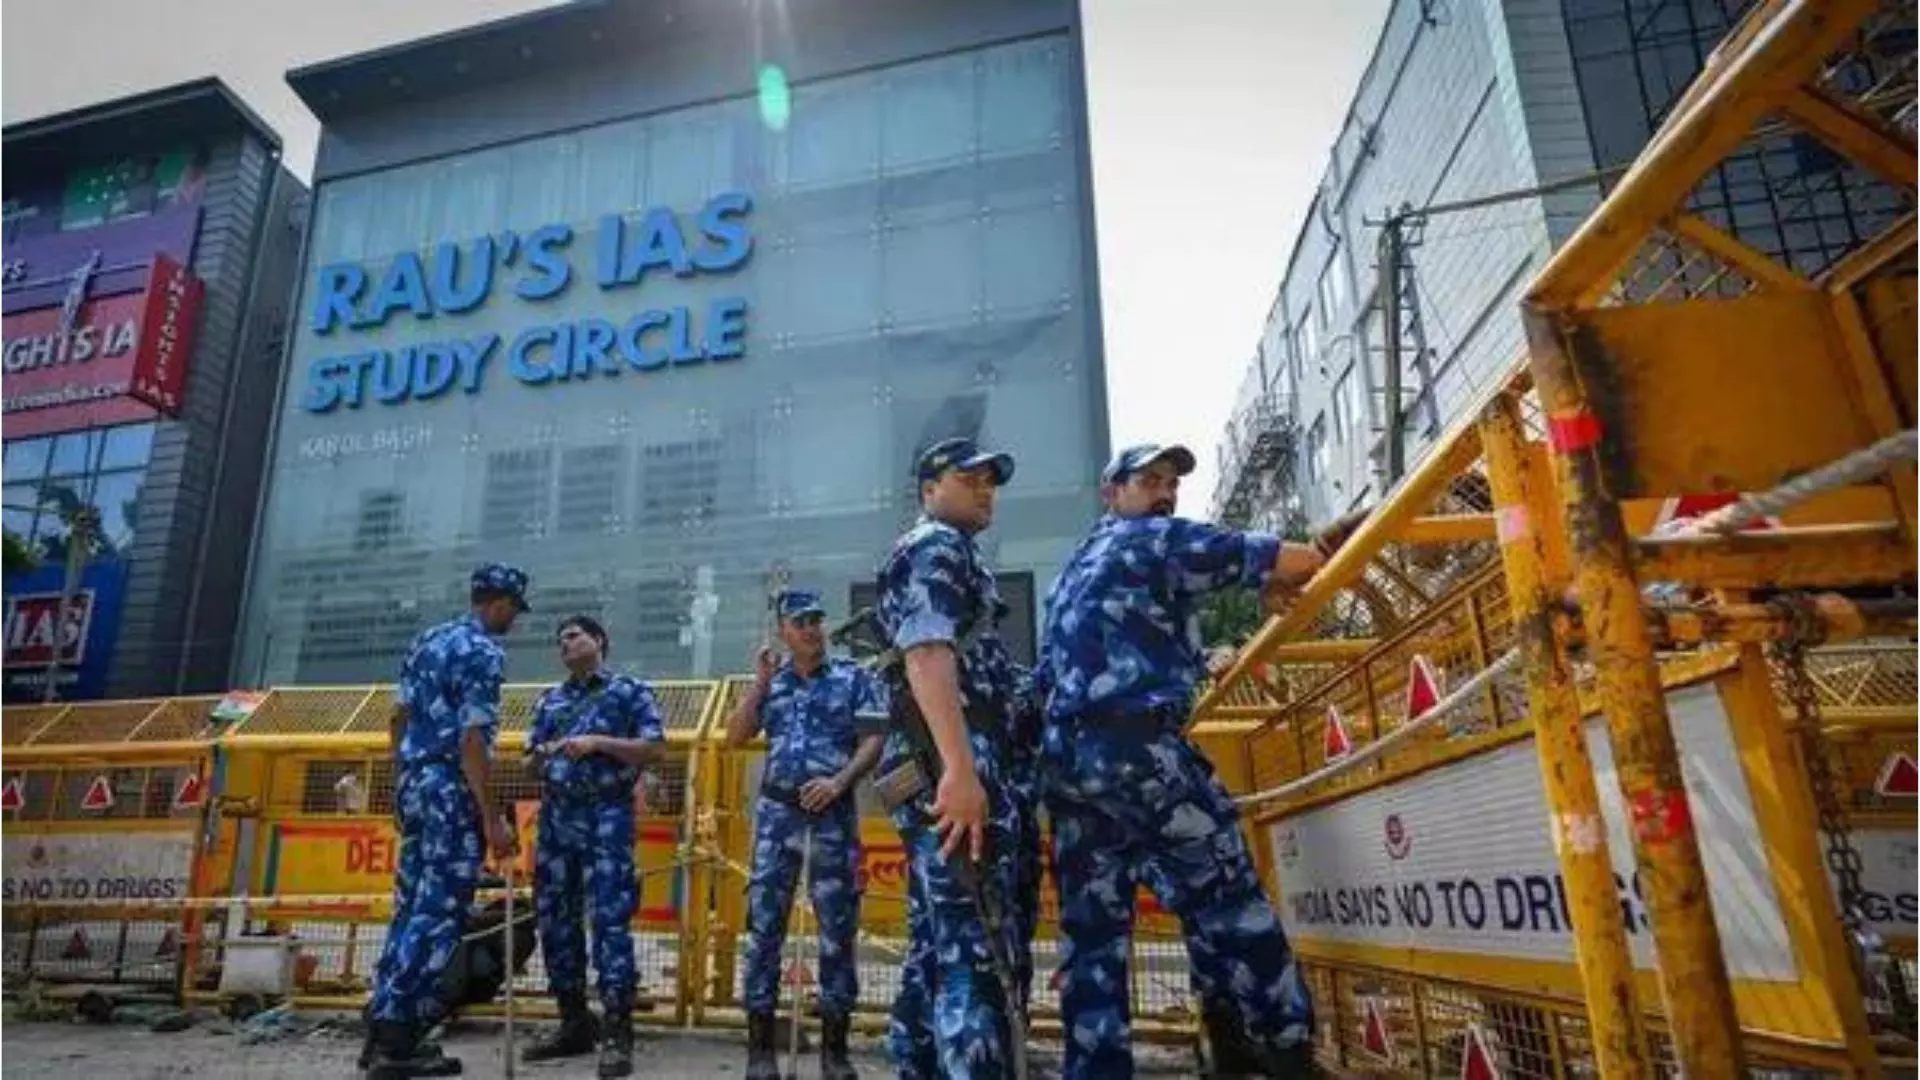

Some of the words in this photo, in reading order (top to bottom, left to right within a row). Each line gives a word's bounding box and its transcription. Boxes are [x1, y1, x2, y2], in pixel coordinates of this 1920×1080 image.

[313, 224, 573, 336] RAU'S
[597, 193, 755, 290] IAS
[303, 333, 501, 413] STUDY
[510, 298, 748, 386] CIRCLE
[20, 878, 52, 899] NO
[59, 878, 90, 899] TO
[96, 878, 175, 899] DRUGS
[1289, 888, 1335, 924] DIA
[1336, 885, 1392, 928] SAYS
[1394, 882, 1434, 928] NO
[1436, 878, 1486, 931] TO
